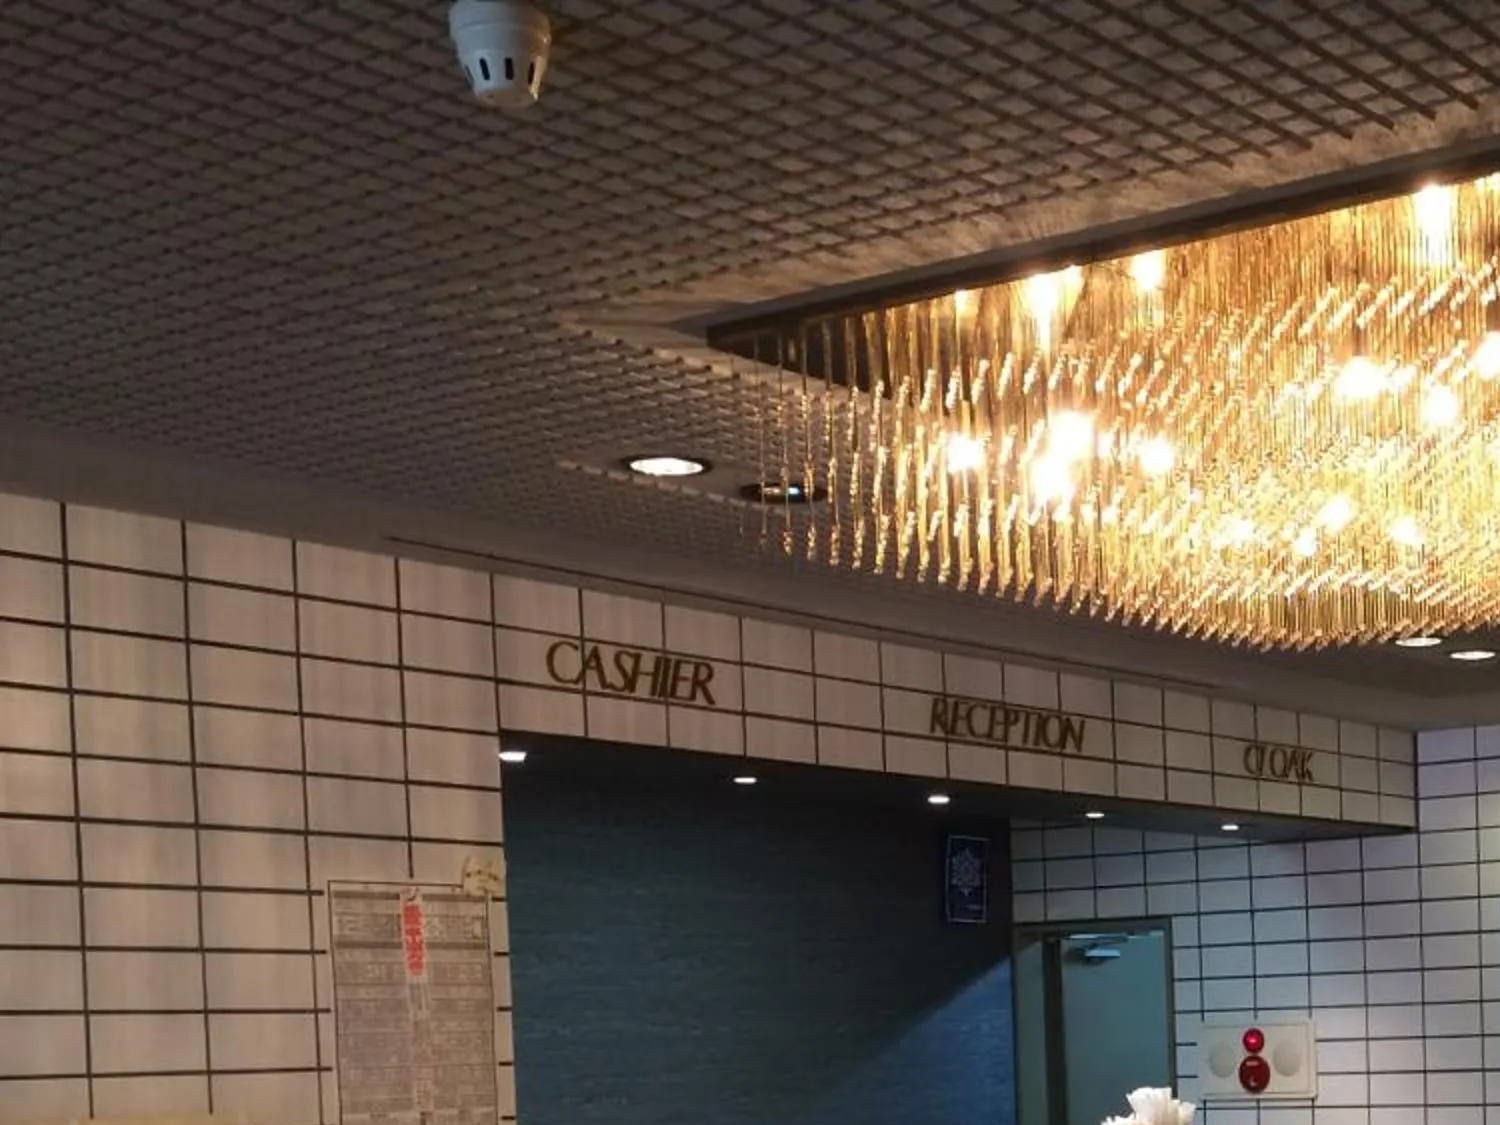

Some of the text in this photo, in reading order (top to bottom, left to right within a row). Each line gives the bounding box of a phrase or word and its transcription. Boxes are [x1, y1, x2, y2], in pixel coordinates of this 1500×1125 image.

[546, 641, 716, 706] CASHIER
[930, 697, 1085, 753] RECEPTION
[1243, 743, 1314, 783] CLOAK
